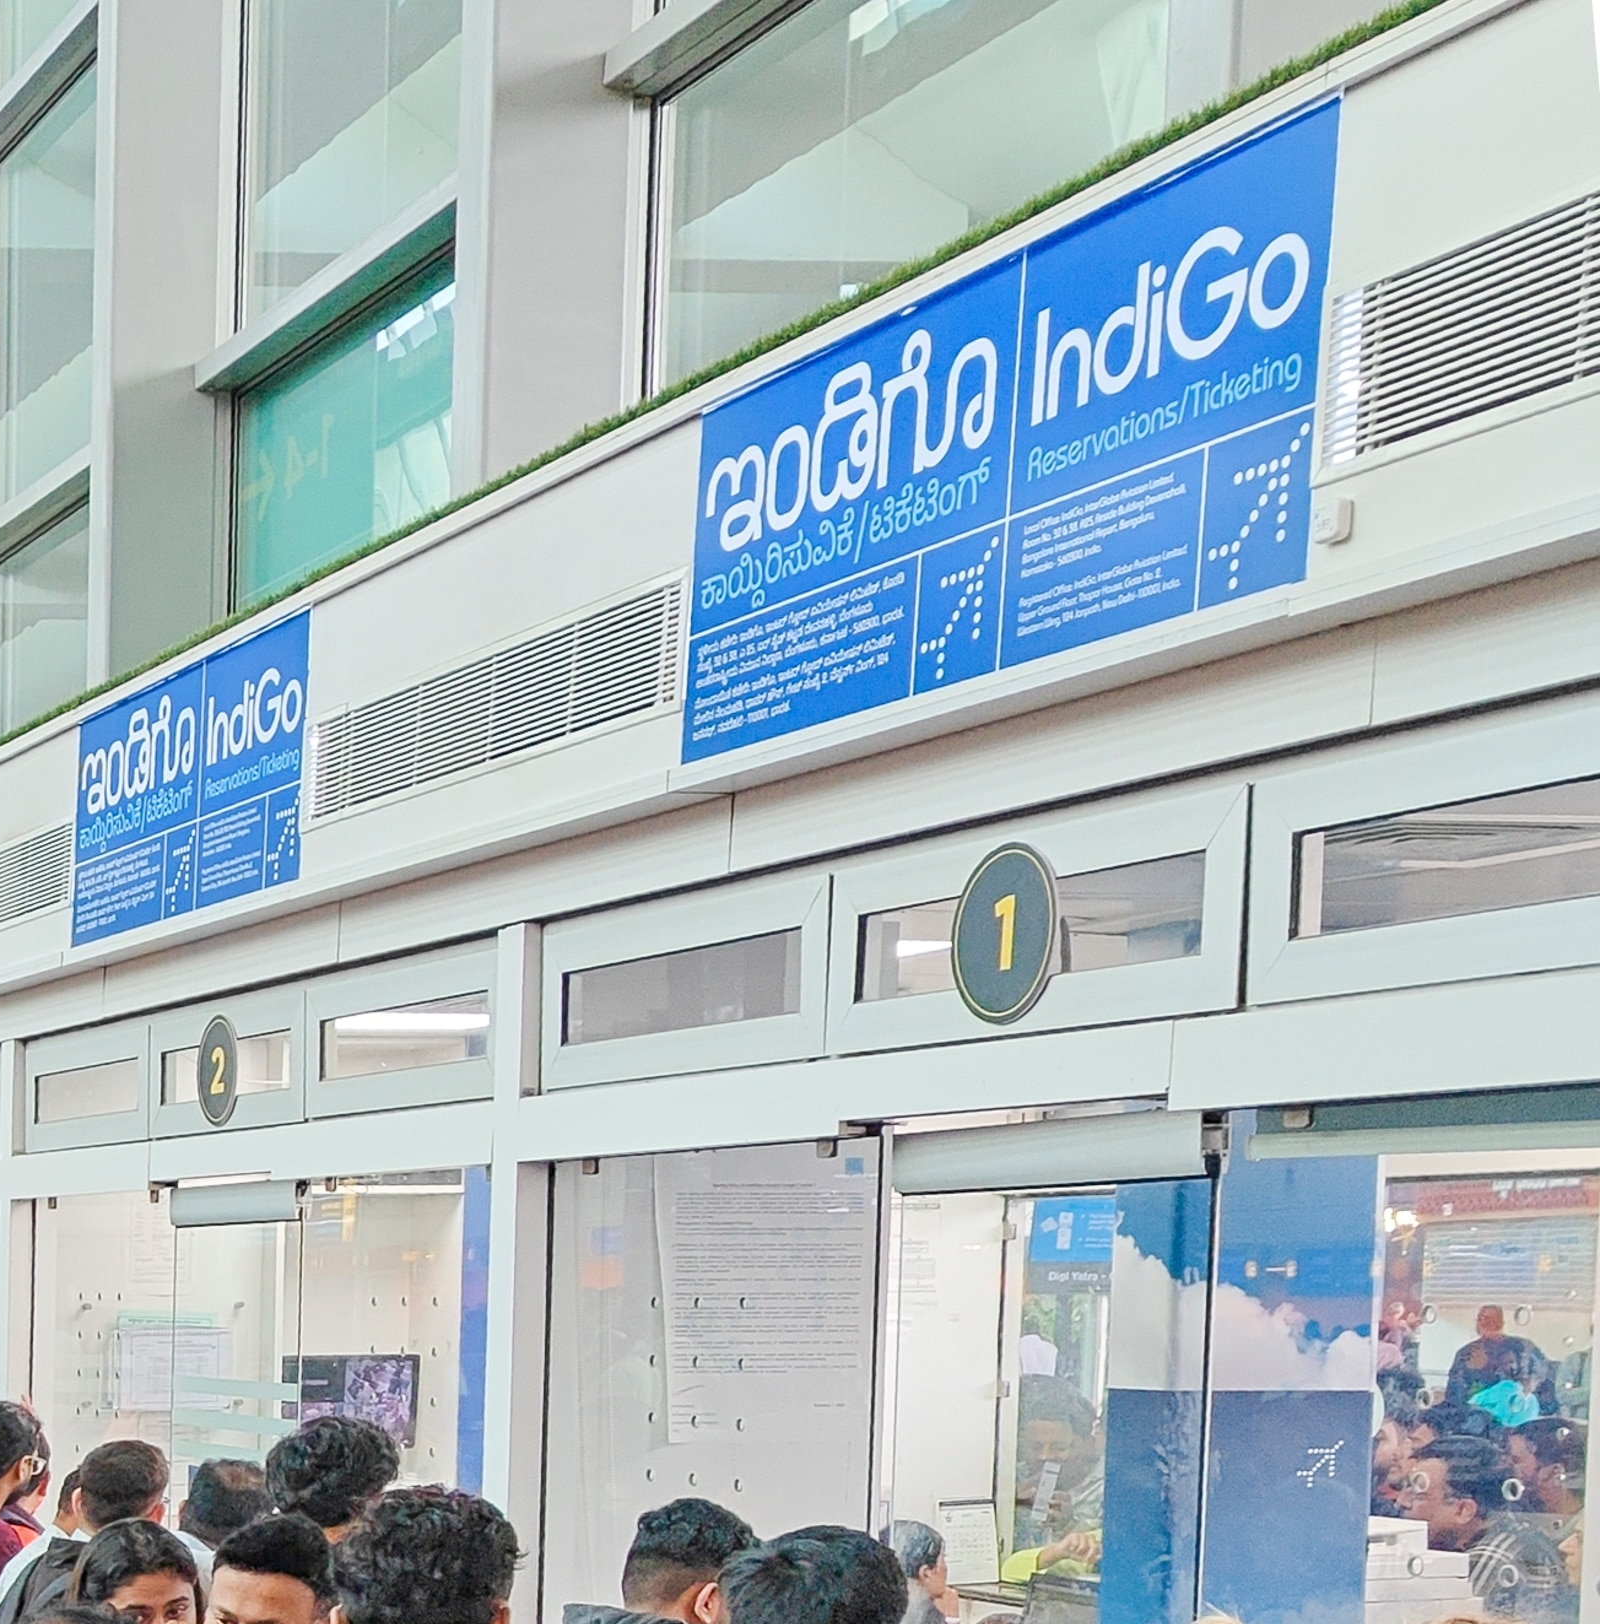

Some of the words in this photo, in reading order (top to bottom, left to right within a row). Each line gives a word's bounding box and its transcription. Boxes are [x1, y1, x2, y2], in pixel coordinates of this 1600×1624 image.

[1031, 225, 1310, 426] IndiGo
[1027, 352, 1302, 482] Reservations/Ticketing
[206, 666, 303, 767] IndiGo
[204, 748, 300, 800] Reservations/Ticketing
[995, 893, 1016, 970] 1
[211, 1046, 226, 1094] 2
